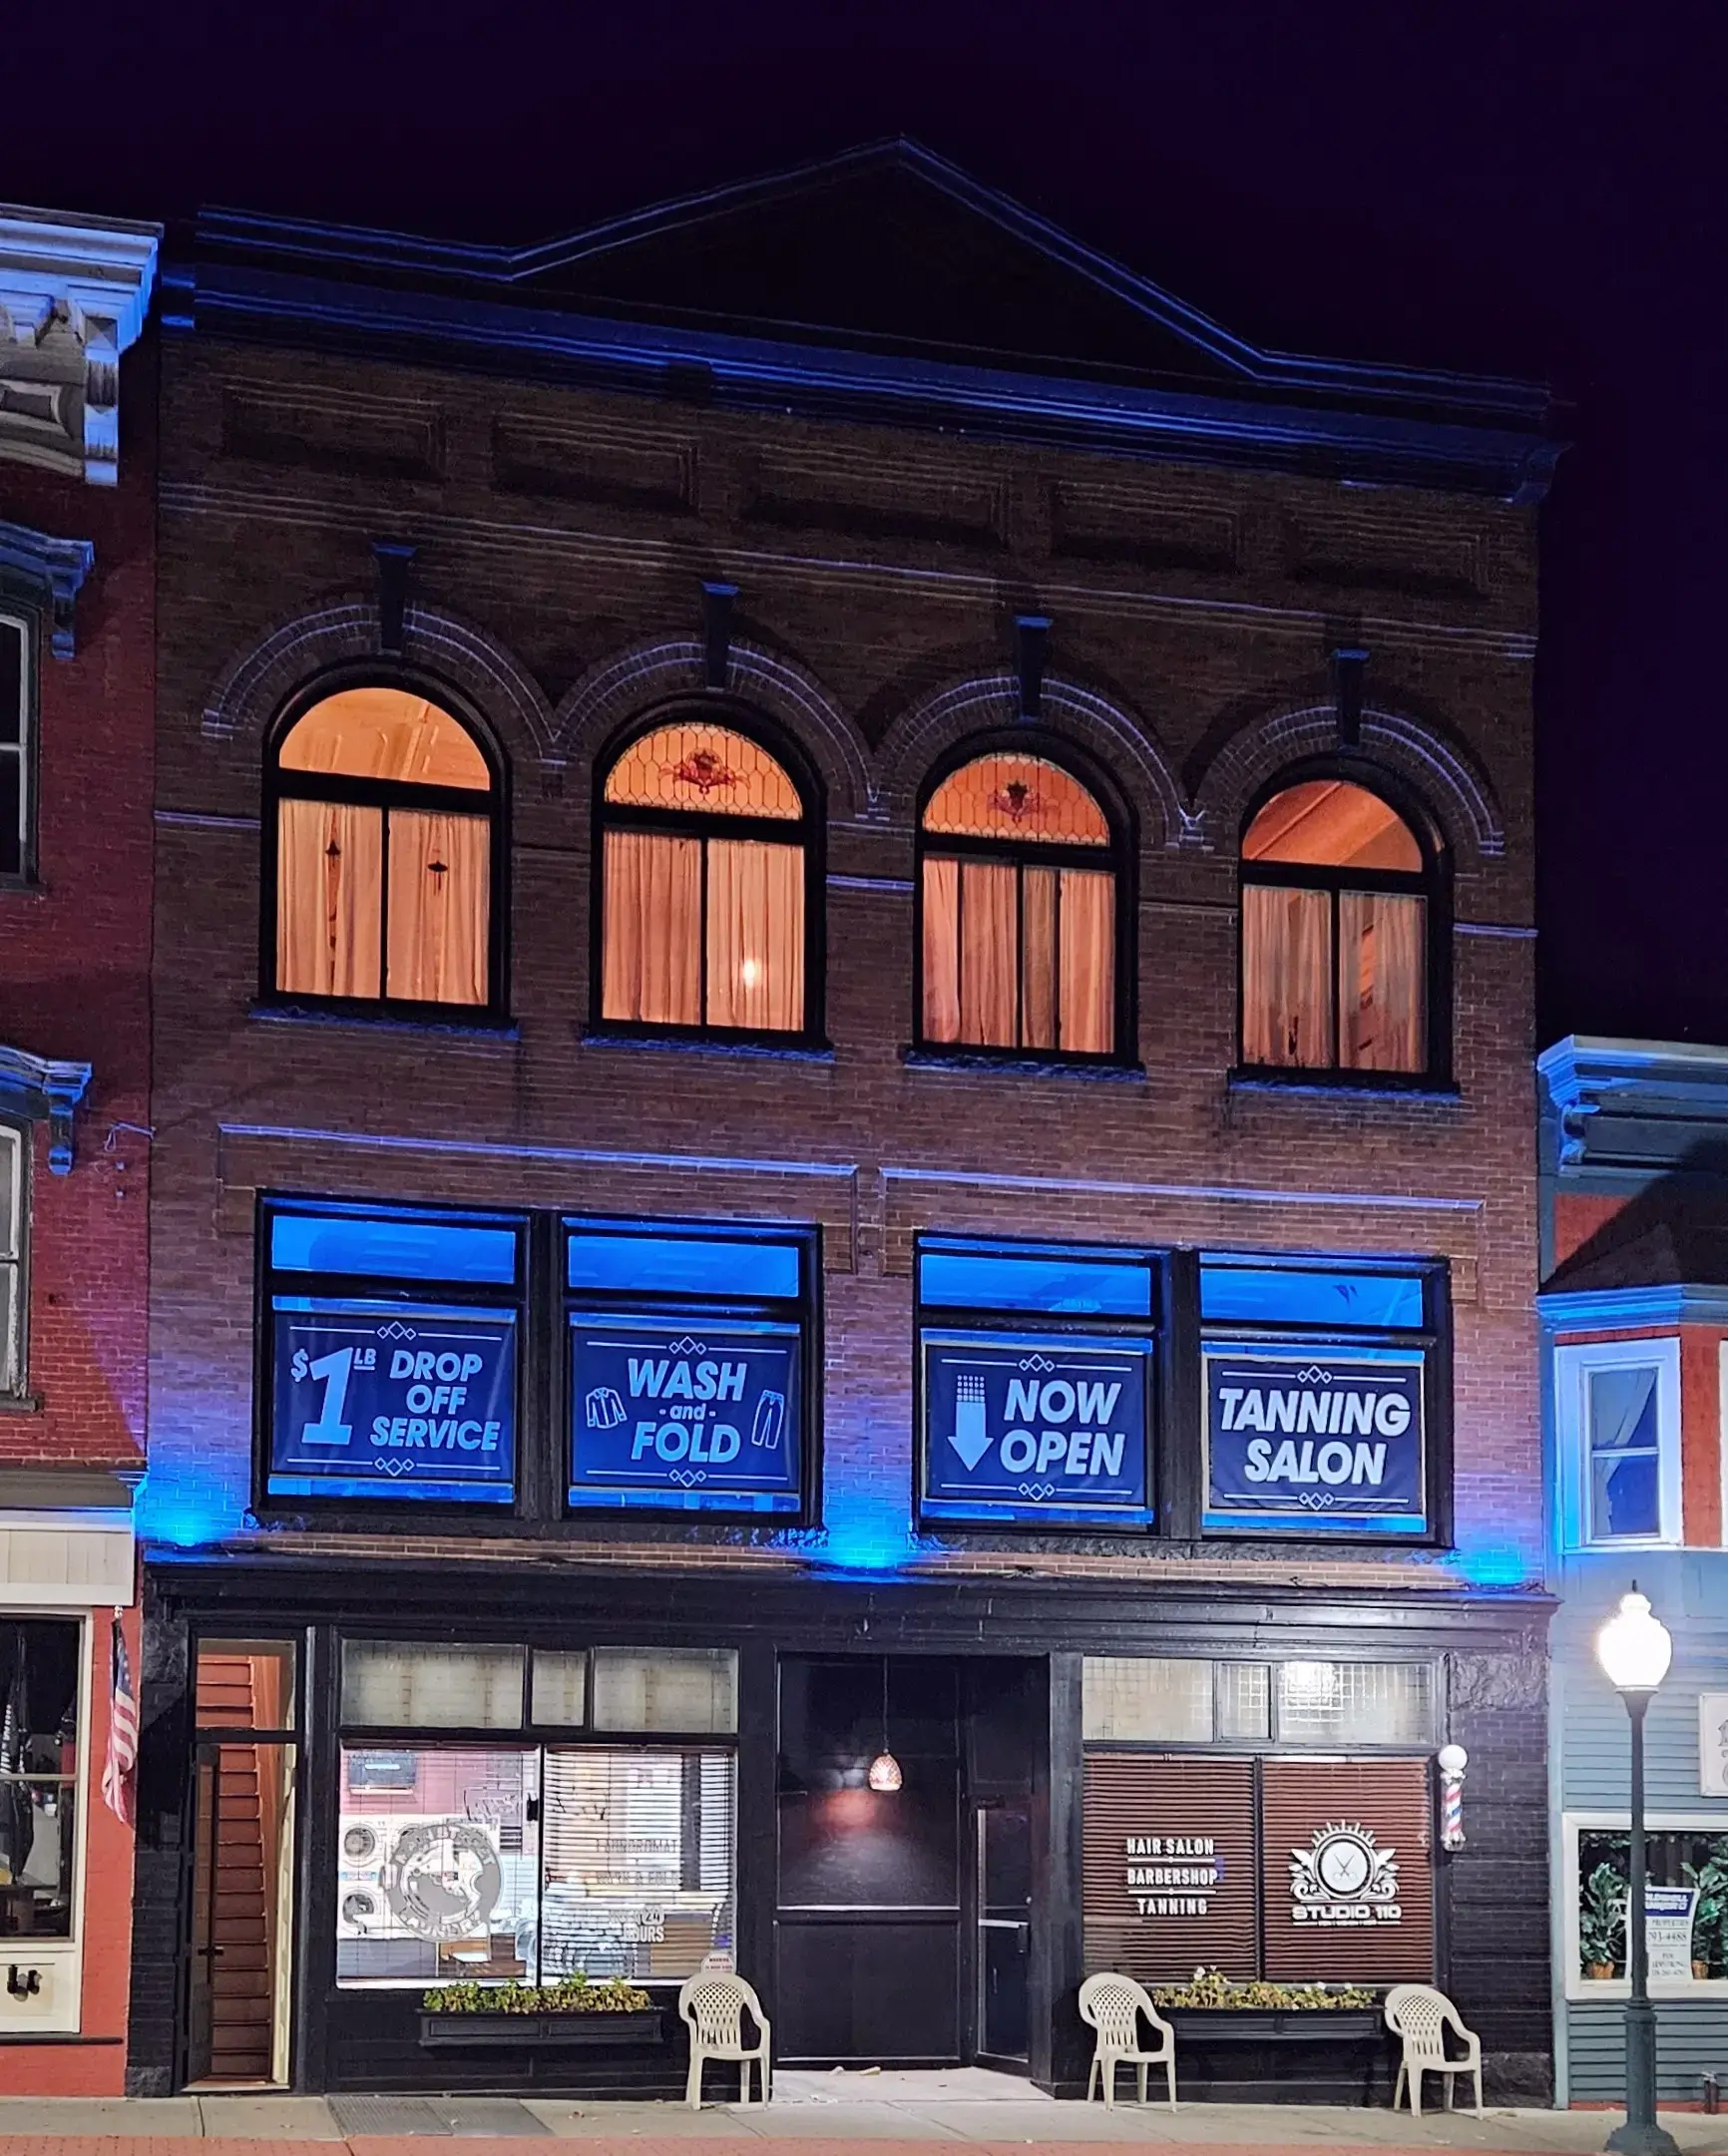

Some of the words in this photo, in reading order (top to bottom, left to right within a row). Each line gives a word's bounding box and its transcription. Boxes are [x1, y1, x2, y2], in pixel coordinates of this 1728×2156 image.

[389, 1350, 483, 1383] DROP
[628, 1358, 747, 1402] WASH
[406, 1385, 466, 1416] OFF
[1004, 1379, 1122, 1427] NOW
[1218, 1388, 1411, 1438] TANNING
[370, 1417, 501, 1452] SERVICE
[631, 1422, 741, 1464] FOLD
[1000, 1430, 1126, 1478] OPEN
[1244, 1439, 1387, 1486] SALON
[1126, 1837, 1162, 1855] HAIR
[1165, 1838, 1214, 1856] SALON
[1127, 1868, 1218, 1886] BARBERSHOP
[1136, 1898, 1208, 1916] TANNING
[1292, 1905, 1371, 1920] STUDIO
[1376, 1905, 1402, 1920] 110
